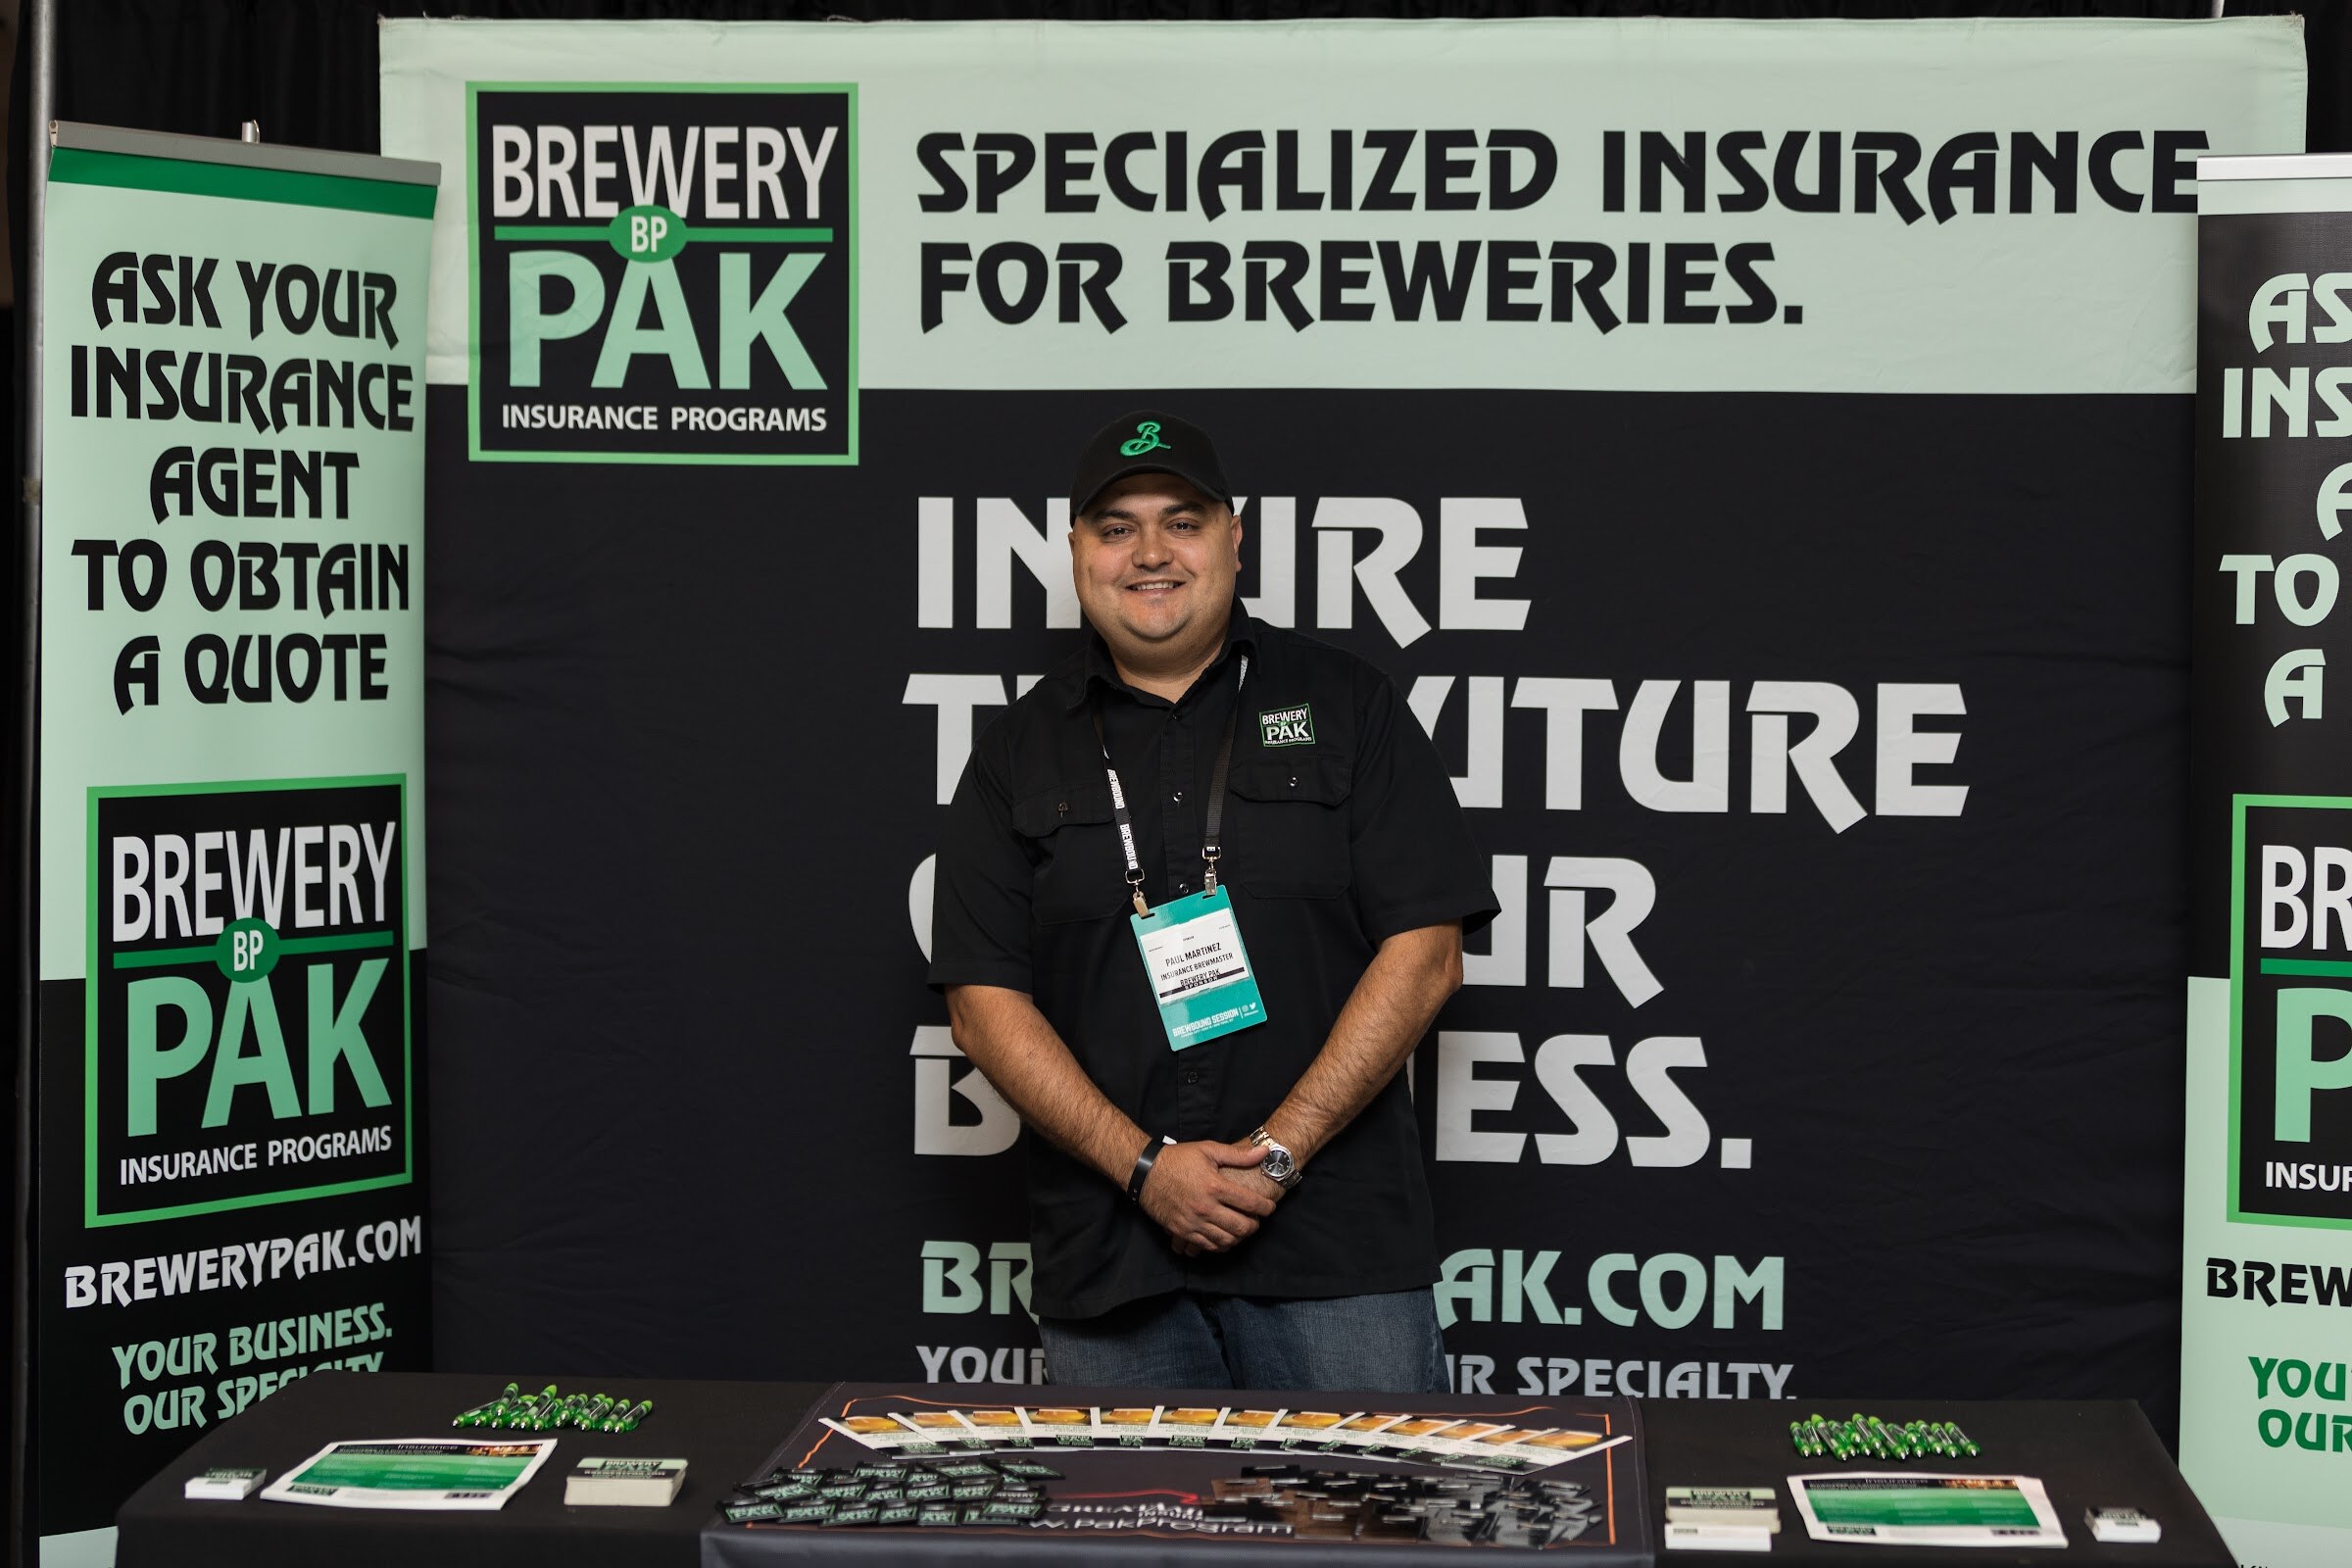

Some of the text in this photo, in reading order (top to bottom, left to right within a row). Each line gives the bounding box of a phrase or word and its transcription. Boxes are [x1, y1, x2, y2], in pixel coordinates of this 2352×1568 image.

[492, 125, 838, 220] BREWERY
[916, 129, 2210, 226] SPECIALIZED INSURANCE
[630, 215, 668, 253] BP
[91, 252, 400, 350] ASK YOUR
[509, 249, 828, 390] PAK
[920, 240, 1803, 335] FOR BREWERIES.
[71, 345, 414, 435] INSURANCE
[502, 404, 827, 432] INSURANCE PROGRAMS
[149, 446, 360, 525] AGENT
[71, 539, 410, 619] TO OBTAIN
[2219, 553, 2340, 627] TO
[113, 632, 389, 716] A QUOTE
[2264, 648, 2327, 728] A
[1262, 707, 1307, 725] BREWERY
[1266, 721, 1309, 741] PAK
[1106, 768, 1125, 809] BREWBOUND
[113, 821, 396, 943] BREWERY
[1119, 823, 1139, 870] BREWBOUND
[232, 929, 265, 973] BP
[1160, 953, 1234, 981] INSURANCE BREWMASTER
[1165, 942, 1222, 967] PAUL MARTINEZ
[1179, 968, 1221, 987] BREWERY PAK
[126, 956, 393, 1138] PAK
[1172, 1016, 1212, 1038] BREWBOUND
[1211, 1007, 1240, 1024] SESSION
[120, 1125, 392, 1186] INSURANCE PROGRAMS
[65, 1215, 422, 1309] BREWERYPAK.COM
[112, 1301, 393, 1391] YOUR BUSINESS.
[123, 1385, 208, 1436] OUR
